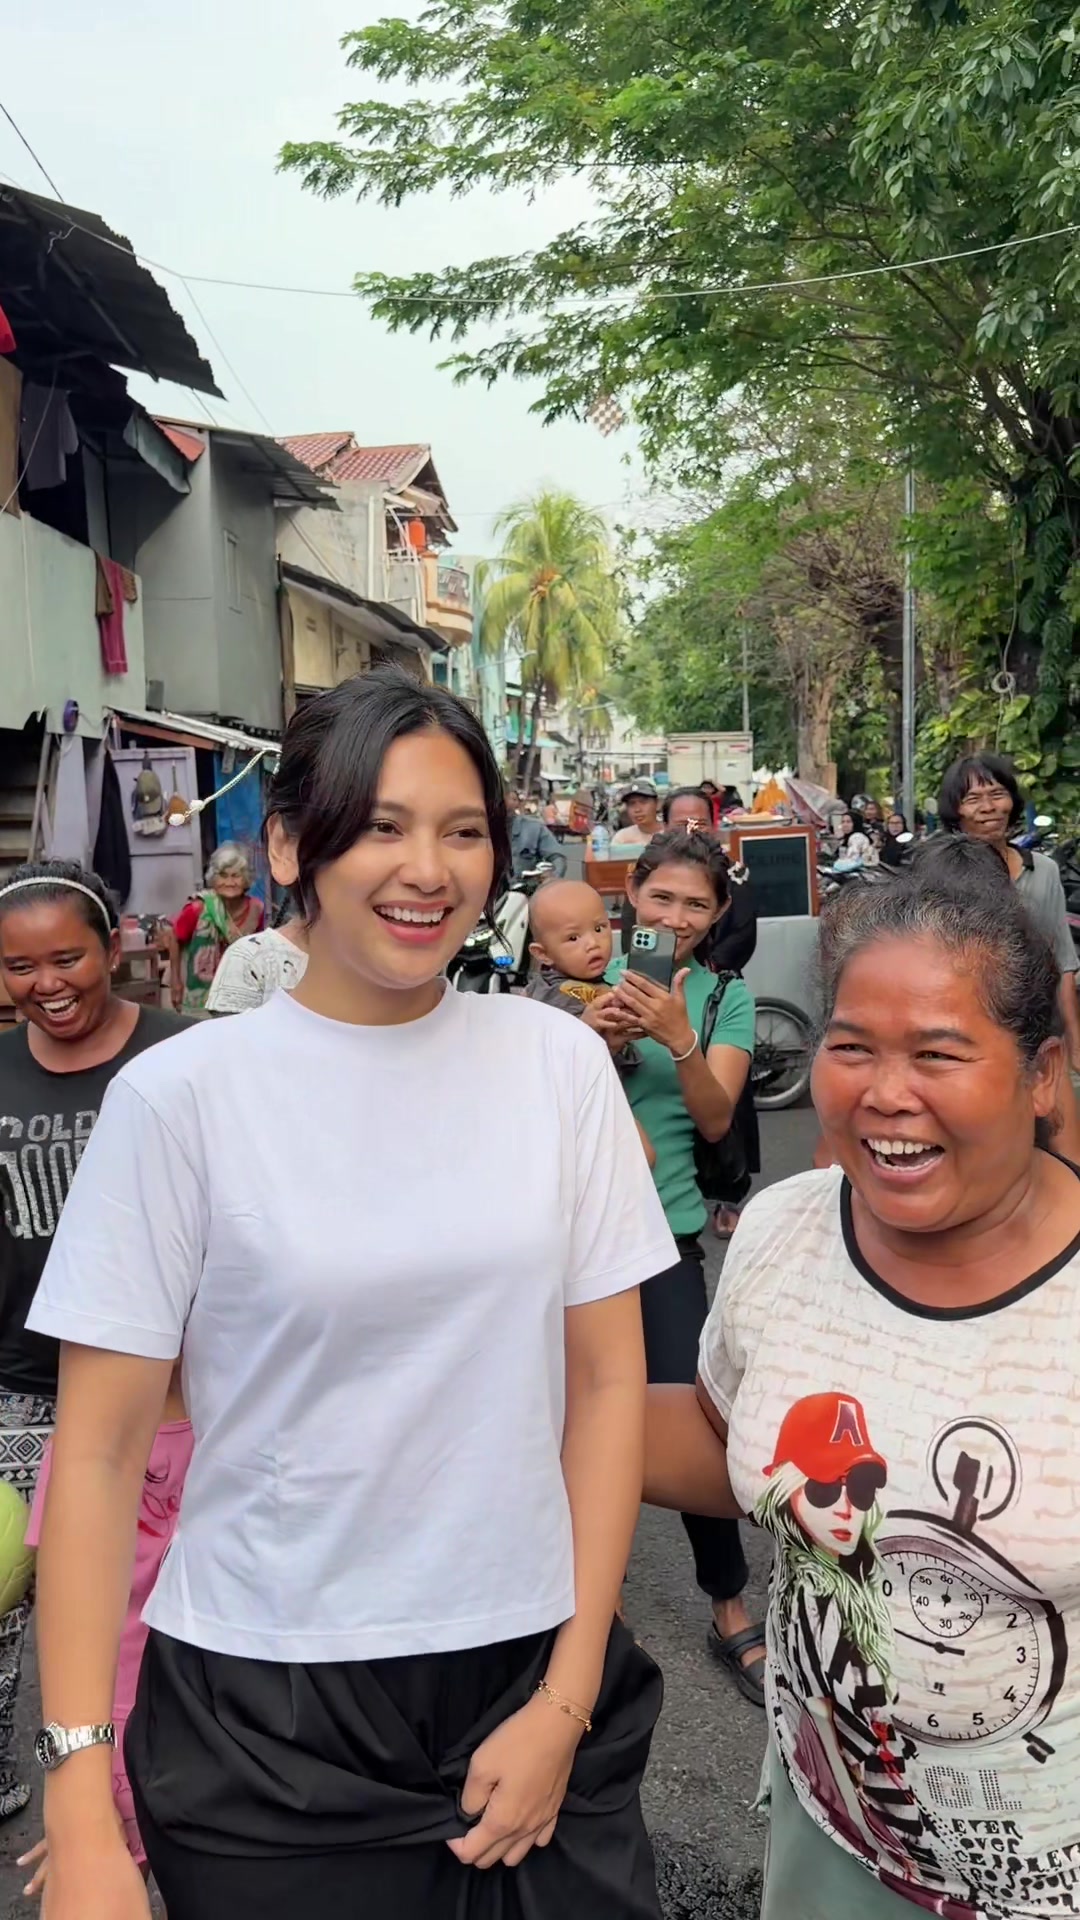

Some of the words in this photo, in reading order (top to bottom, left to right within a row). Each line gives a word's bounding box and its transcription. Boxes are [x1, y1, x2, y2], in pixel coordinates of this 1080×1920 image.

[829, 1399, 864, 1447] A
[939, 1618, 952, 1630] 30
[1006, 1612, 1018, 1629] 2
[1016, 1646, 1027, 1664] 3
[1003, 1685, 1017, 1703] 4
[927, 1713, 940, 1728] 6
[972, 1712, 985, 1726] 5
